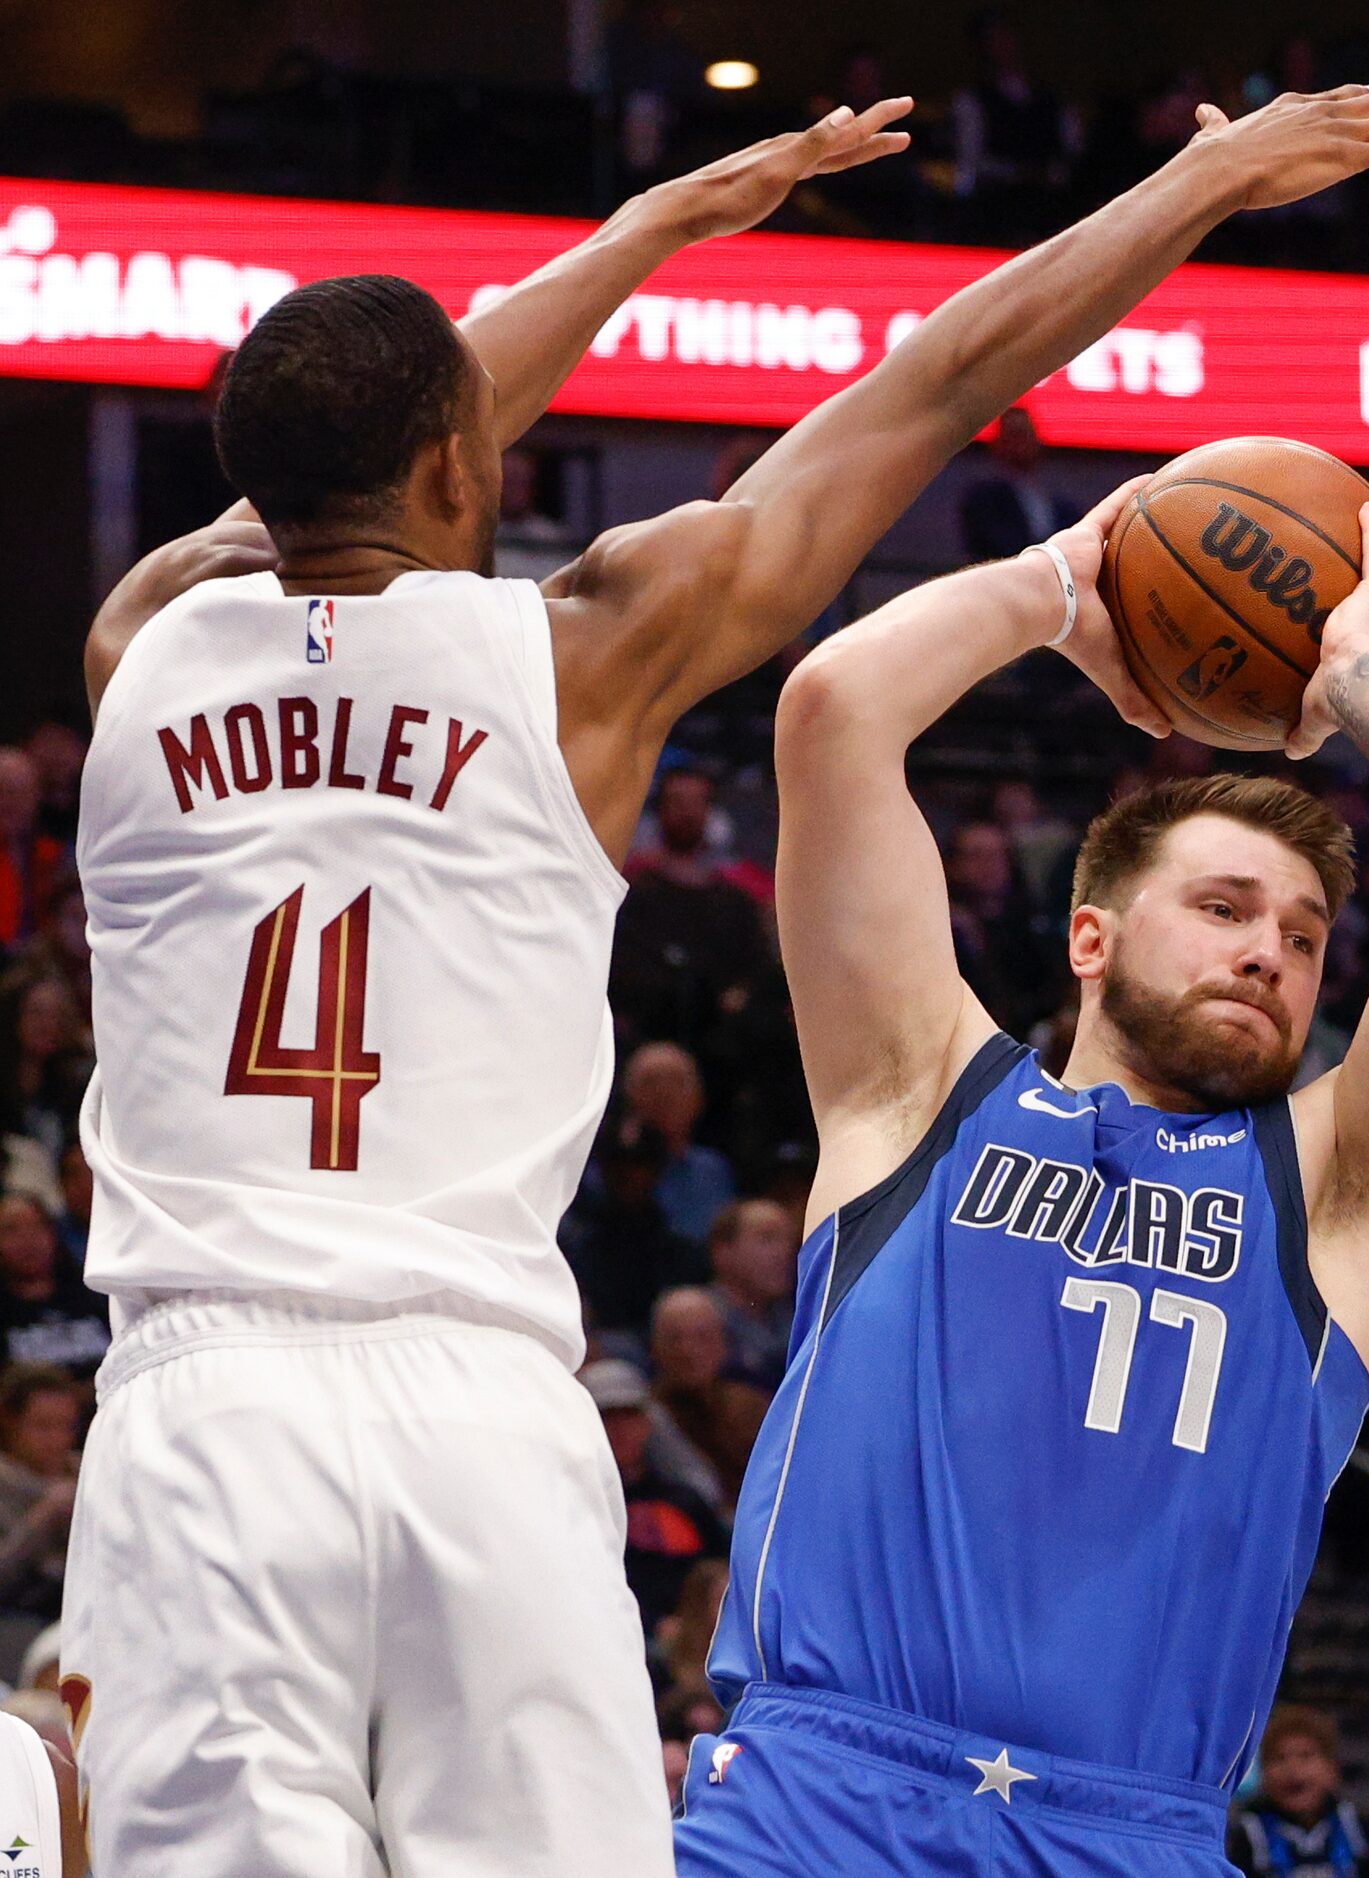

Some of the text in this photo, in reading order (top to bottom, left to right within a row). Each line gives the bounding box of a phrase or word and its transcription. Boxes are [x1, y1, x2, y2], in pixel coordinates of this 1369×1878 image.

[156, 696, 489, 814] MOBLEY
[223, 882, 381, 1172] 4
[950, 1142, 1244, 1283] DALLAS
[1059, 1275, 1228, 1454] 77
